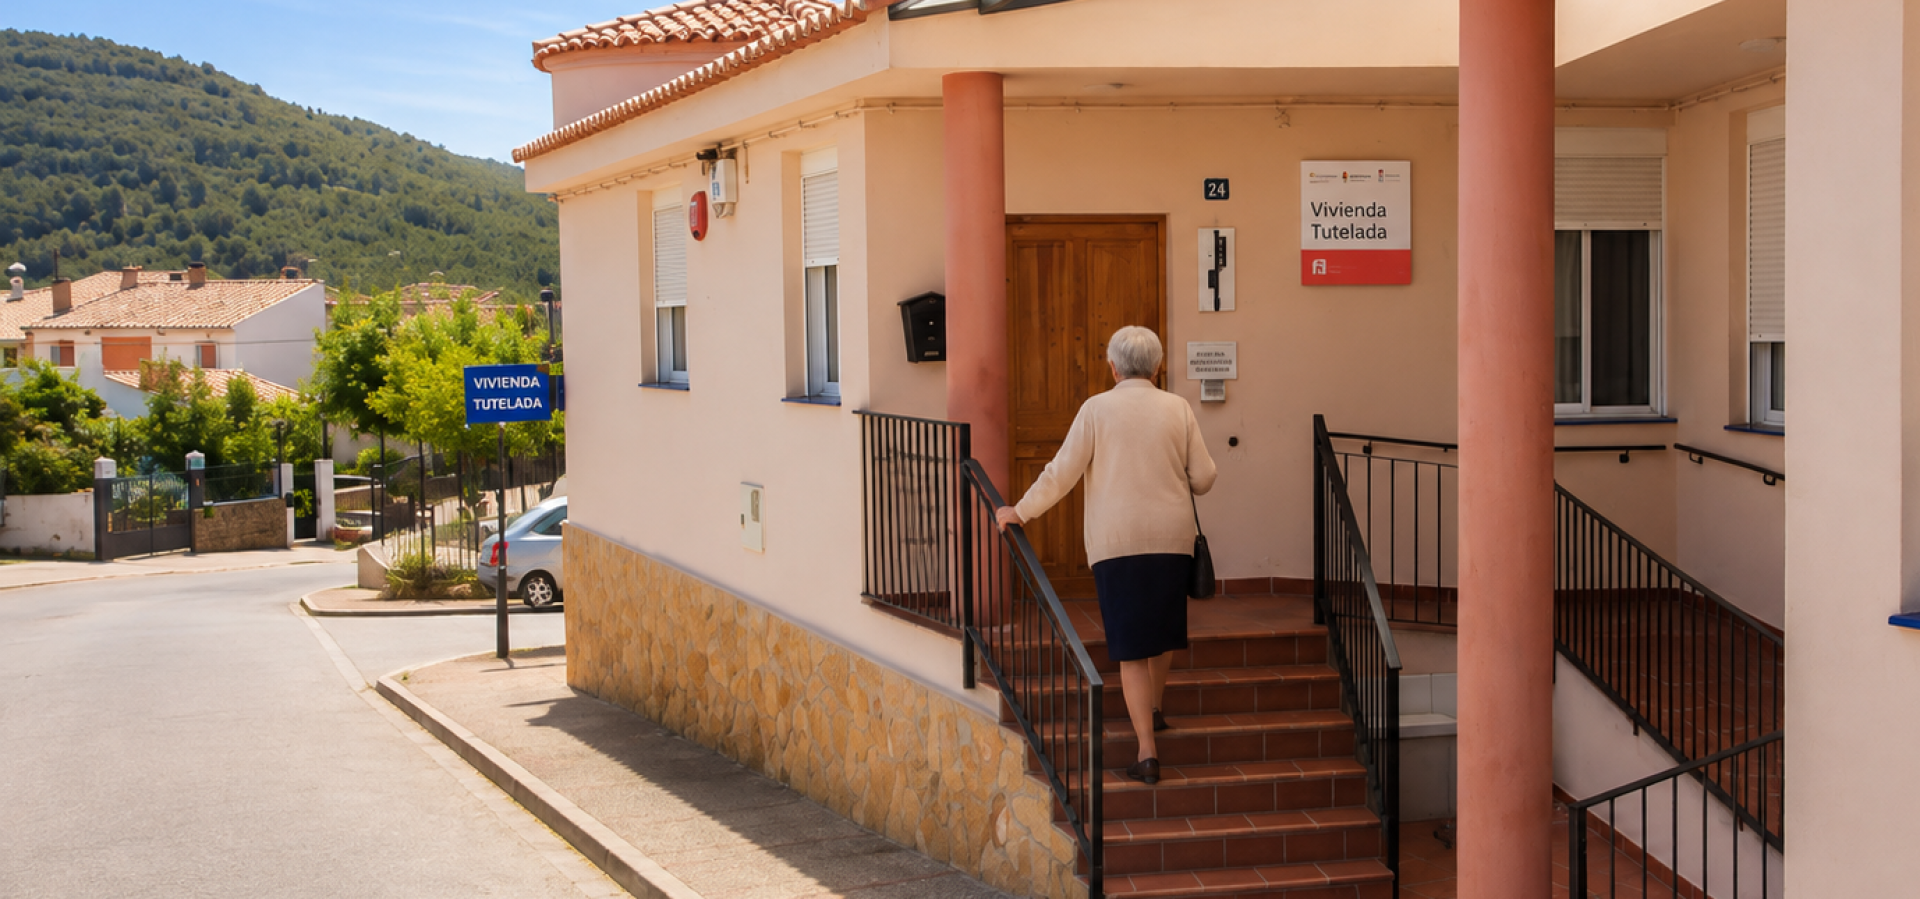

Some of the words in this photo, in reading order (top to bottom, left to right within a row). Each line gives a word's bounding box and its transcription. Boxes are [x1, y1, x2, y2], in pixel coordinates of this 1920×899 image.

[1208, 182, 1226, 198] 24
[1310, 201, 1387, 217] Vivienda
[1310, 223, 1388, 240] Tutelada
[473, 376, 541, 390] VIVIENDA
[473, 396, 543, 410] TUTELADA
